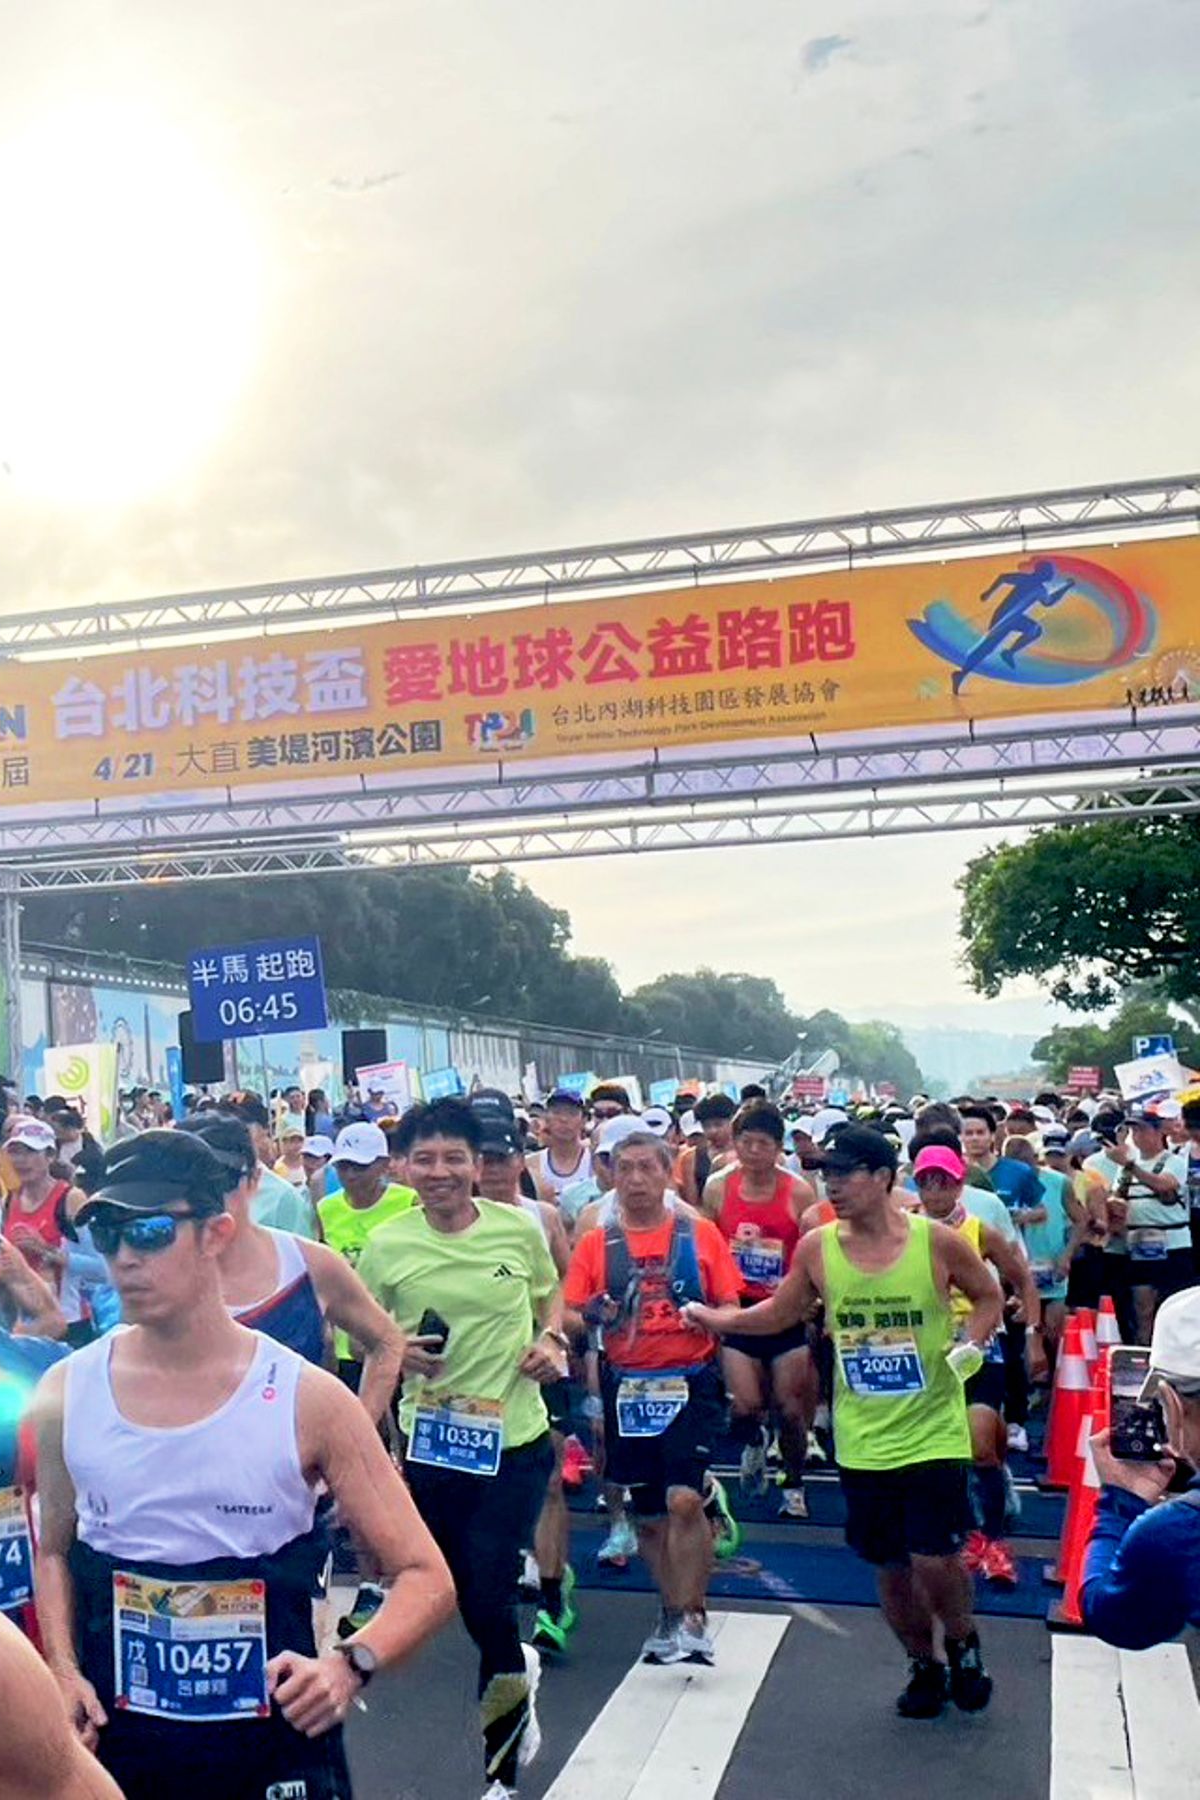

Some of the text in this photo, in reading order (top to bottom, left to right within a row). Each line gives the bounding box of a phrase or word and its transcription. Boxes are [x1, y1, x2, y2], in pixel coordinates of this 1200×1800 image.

[51, 599, 856, 739] 台北科技盃 愛地球公益路跑
[93, 752, 156, 782] 4/21
[192, 949, 316, 987] 半馬 起跑
[220, 992, 298, 1026] 06:45
[1135, 1037, 1151, 1057] P
[862, 1356, 911, 1374] 20071
[637, 1403, 682, 1417] 1022
[438, 1424, 494, 1450] 10334
[155, 1641, 253, 1675] 10457
